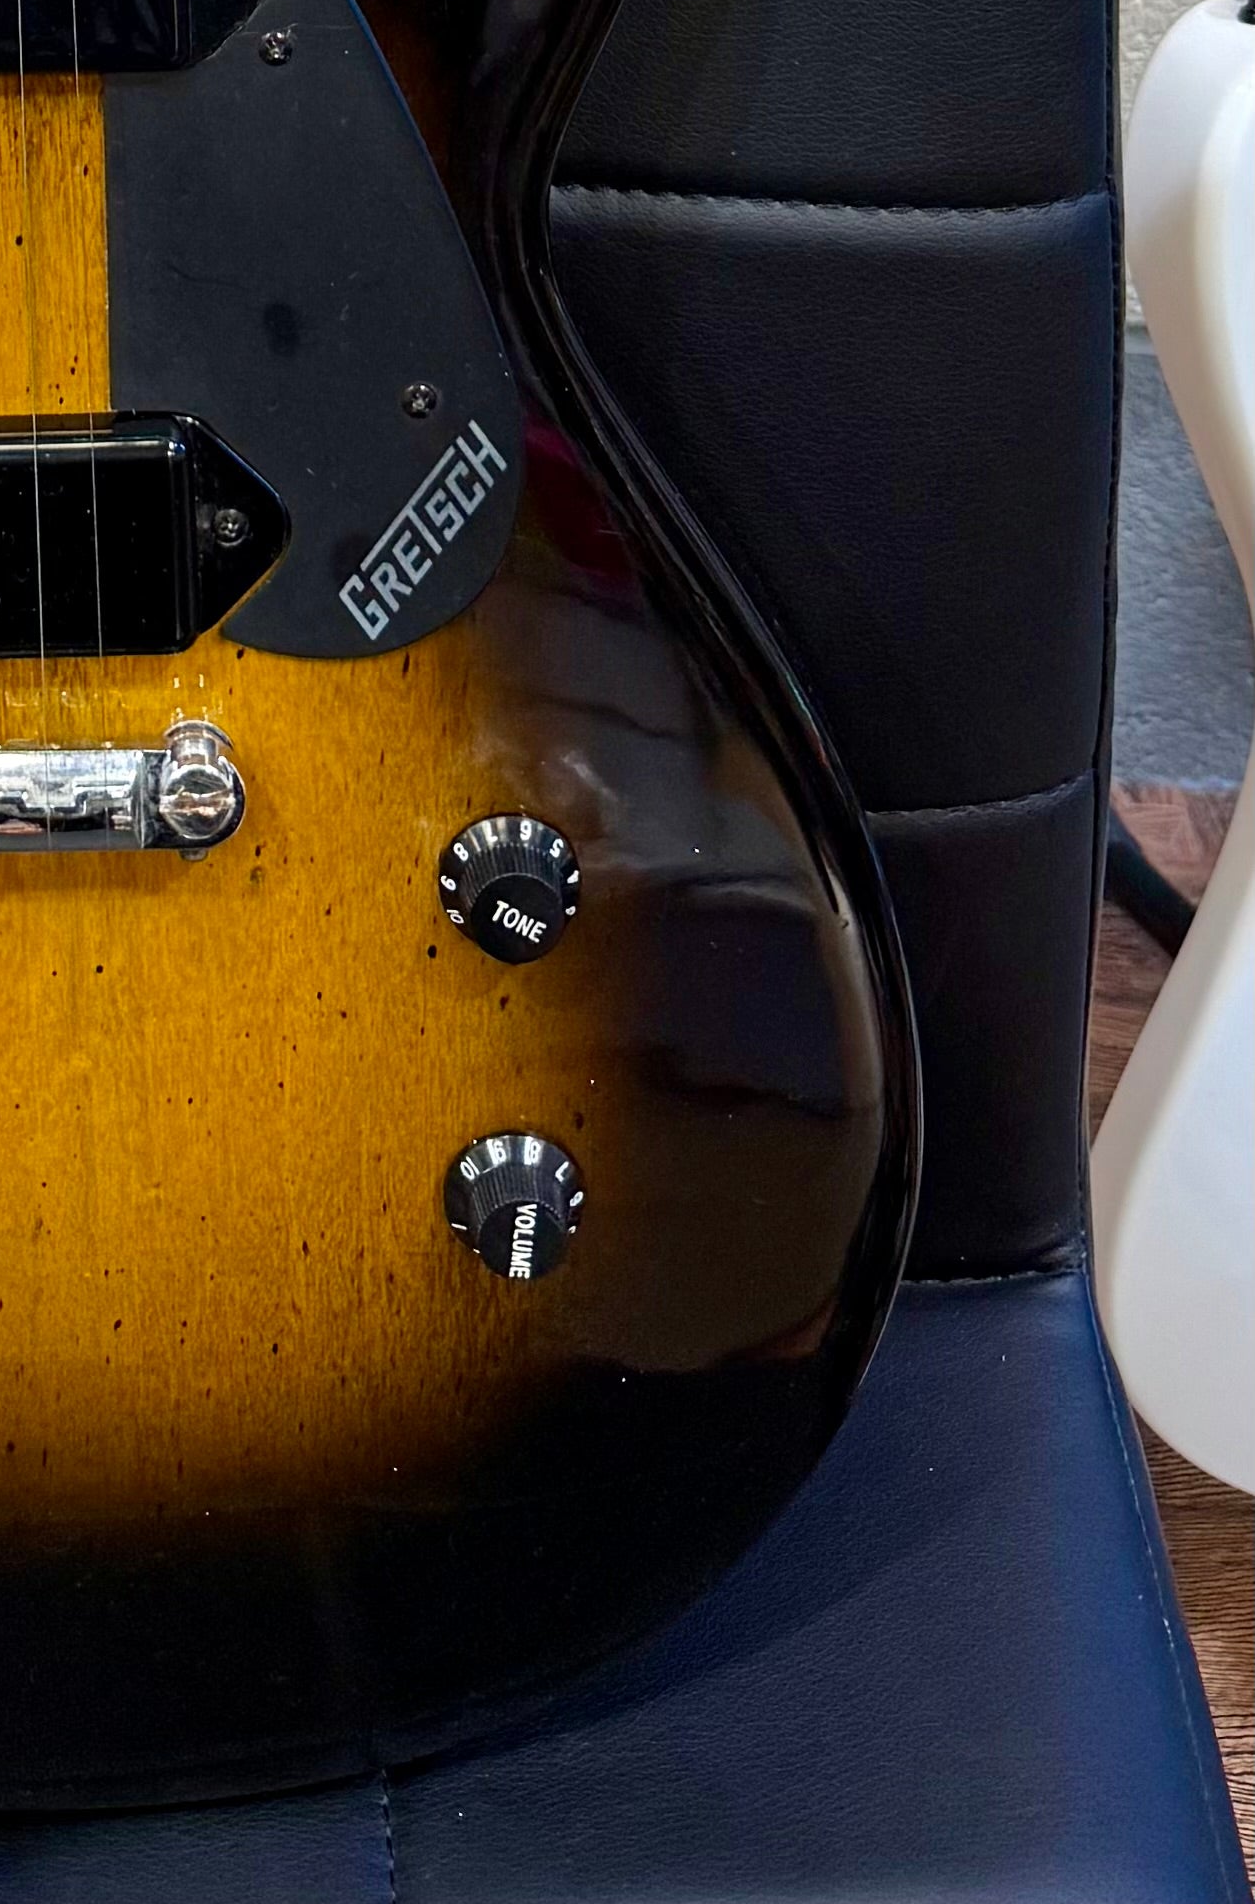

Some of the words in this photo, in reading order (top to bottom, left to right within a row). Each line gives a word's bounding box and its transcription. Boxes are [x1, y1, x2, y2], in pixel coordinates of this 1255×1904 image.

[338, 419, 508, 641] GRETSCH
[492, 900, 547, 943] TONE
[508, 1203, 538, 1280] VOLUME
